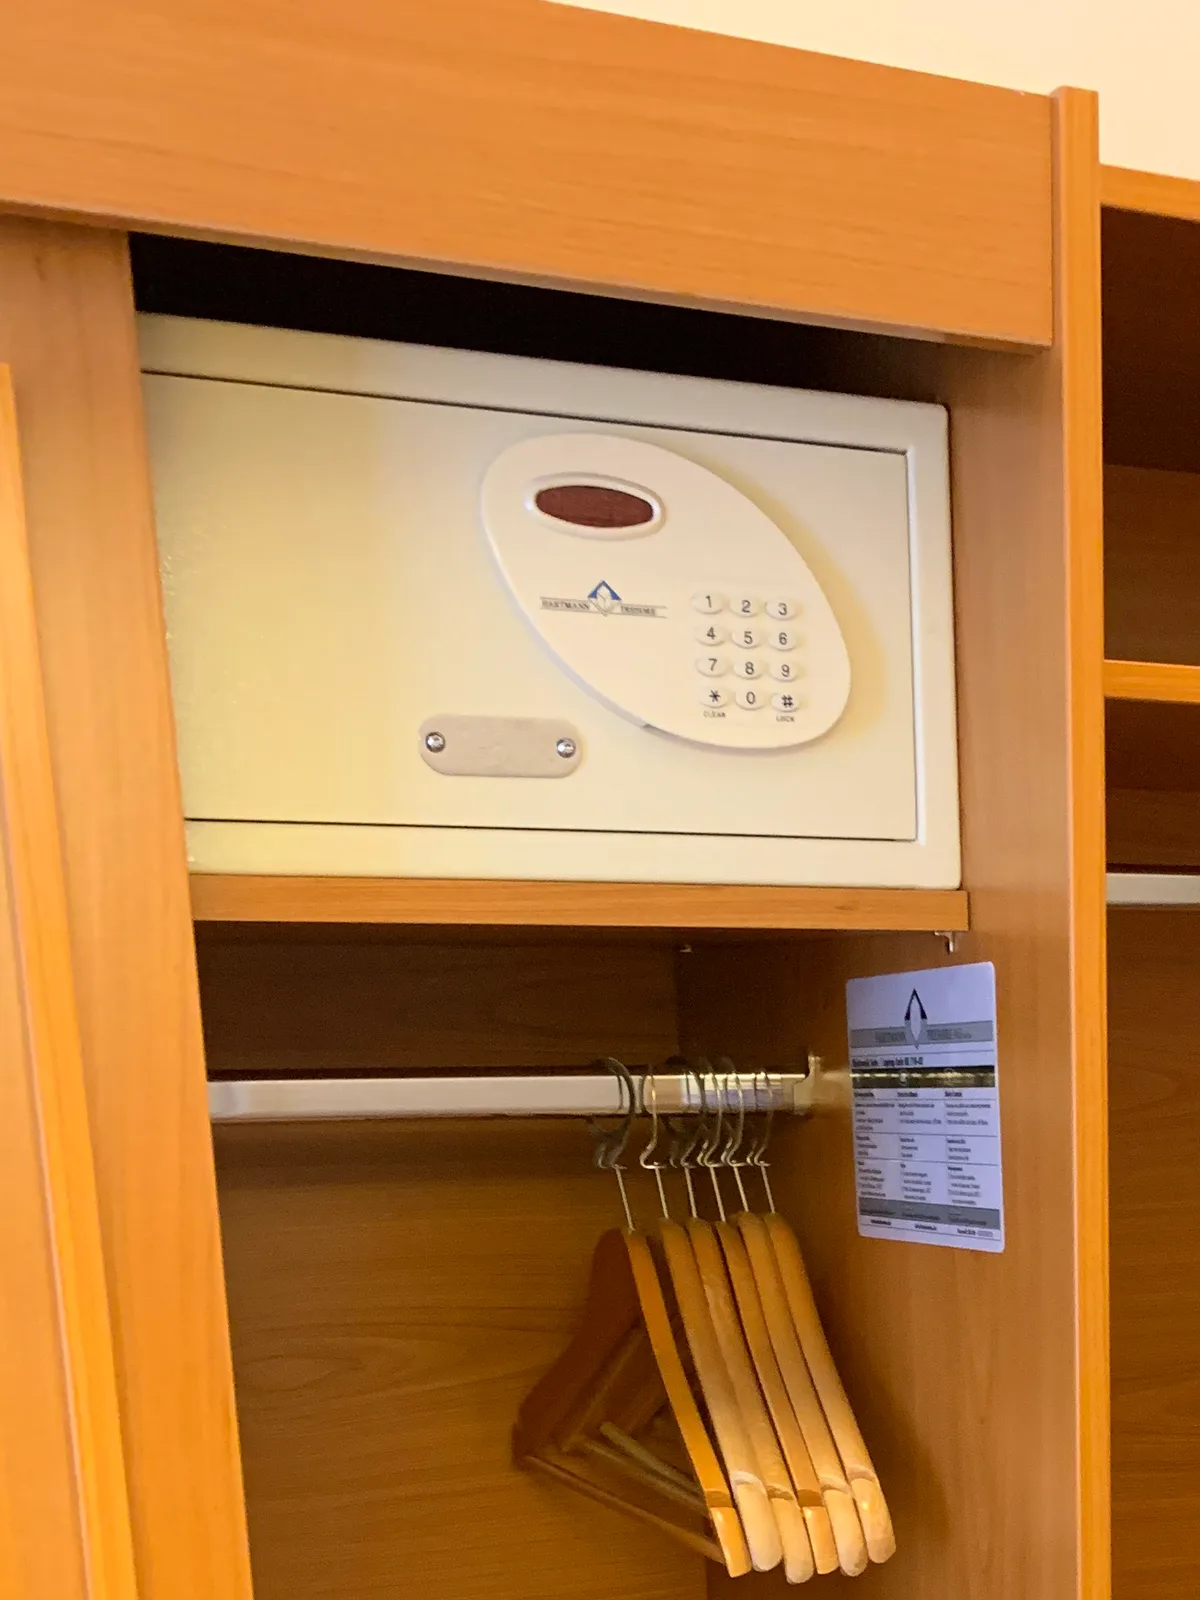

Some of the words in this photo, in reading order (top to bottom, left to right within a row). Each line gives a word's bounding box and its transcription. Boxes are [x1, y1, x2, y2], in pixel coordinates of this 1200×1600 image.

[705, 595, 712, 608] 1
[741, 599, 751, 613] 2
[778, 602, 788, 616] 3
[706, 626, 716, 640] 4
[743, 630, 753, 645] 5
[778, 632, 788, 646] 6
[708, 658, 718, 671] 7
[744, 661, 755, 675] 8
[781, 664, 790, 677] 9
[745, 691, 756, 705] 0
[703, 710, 726, 718] CLEAR
[776, 715, 795, 723] LOCK
